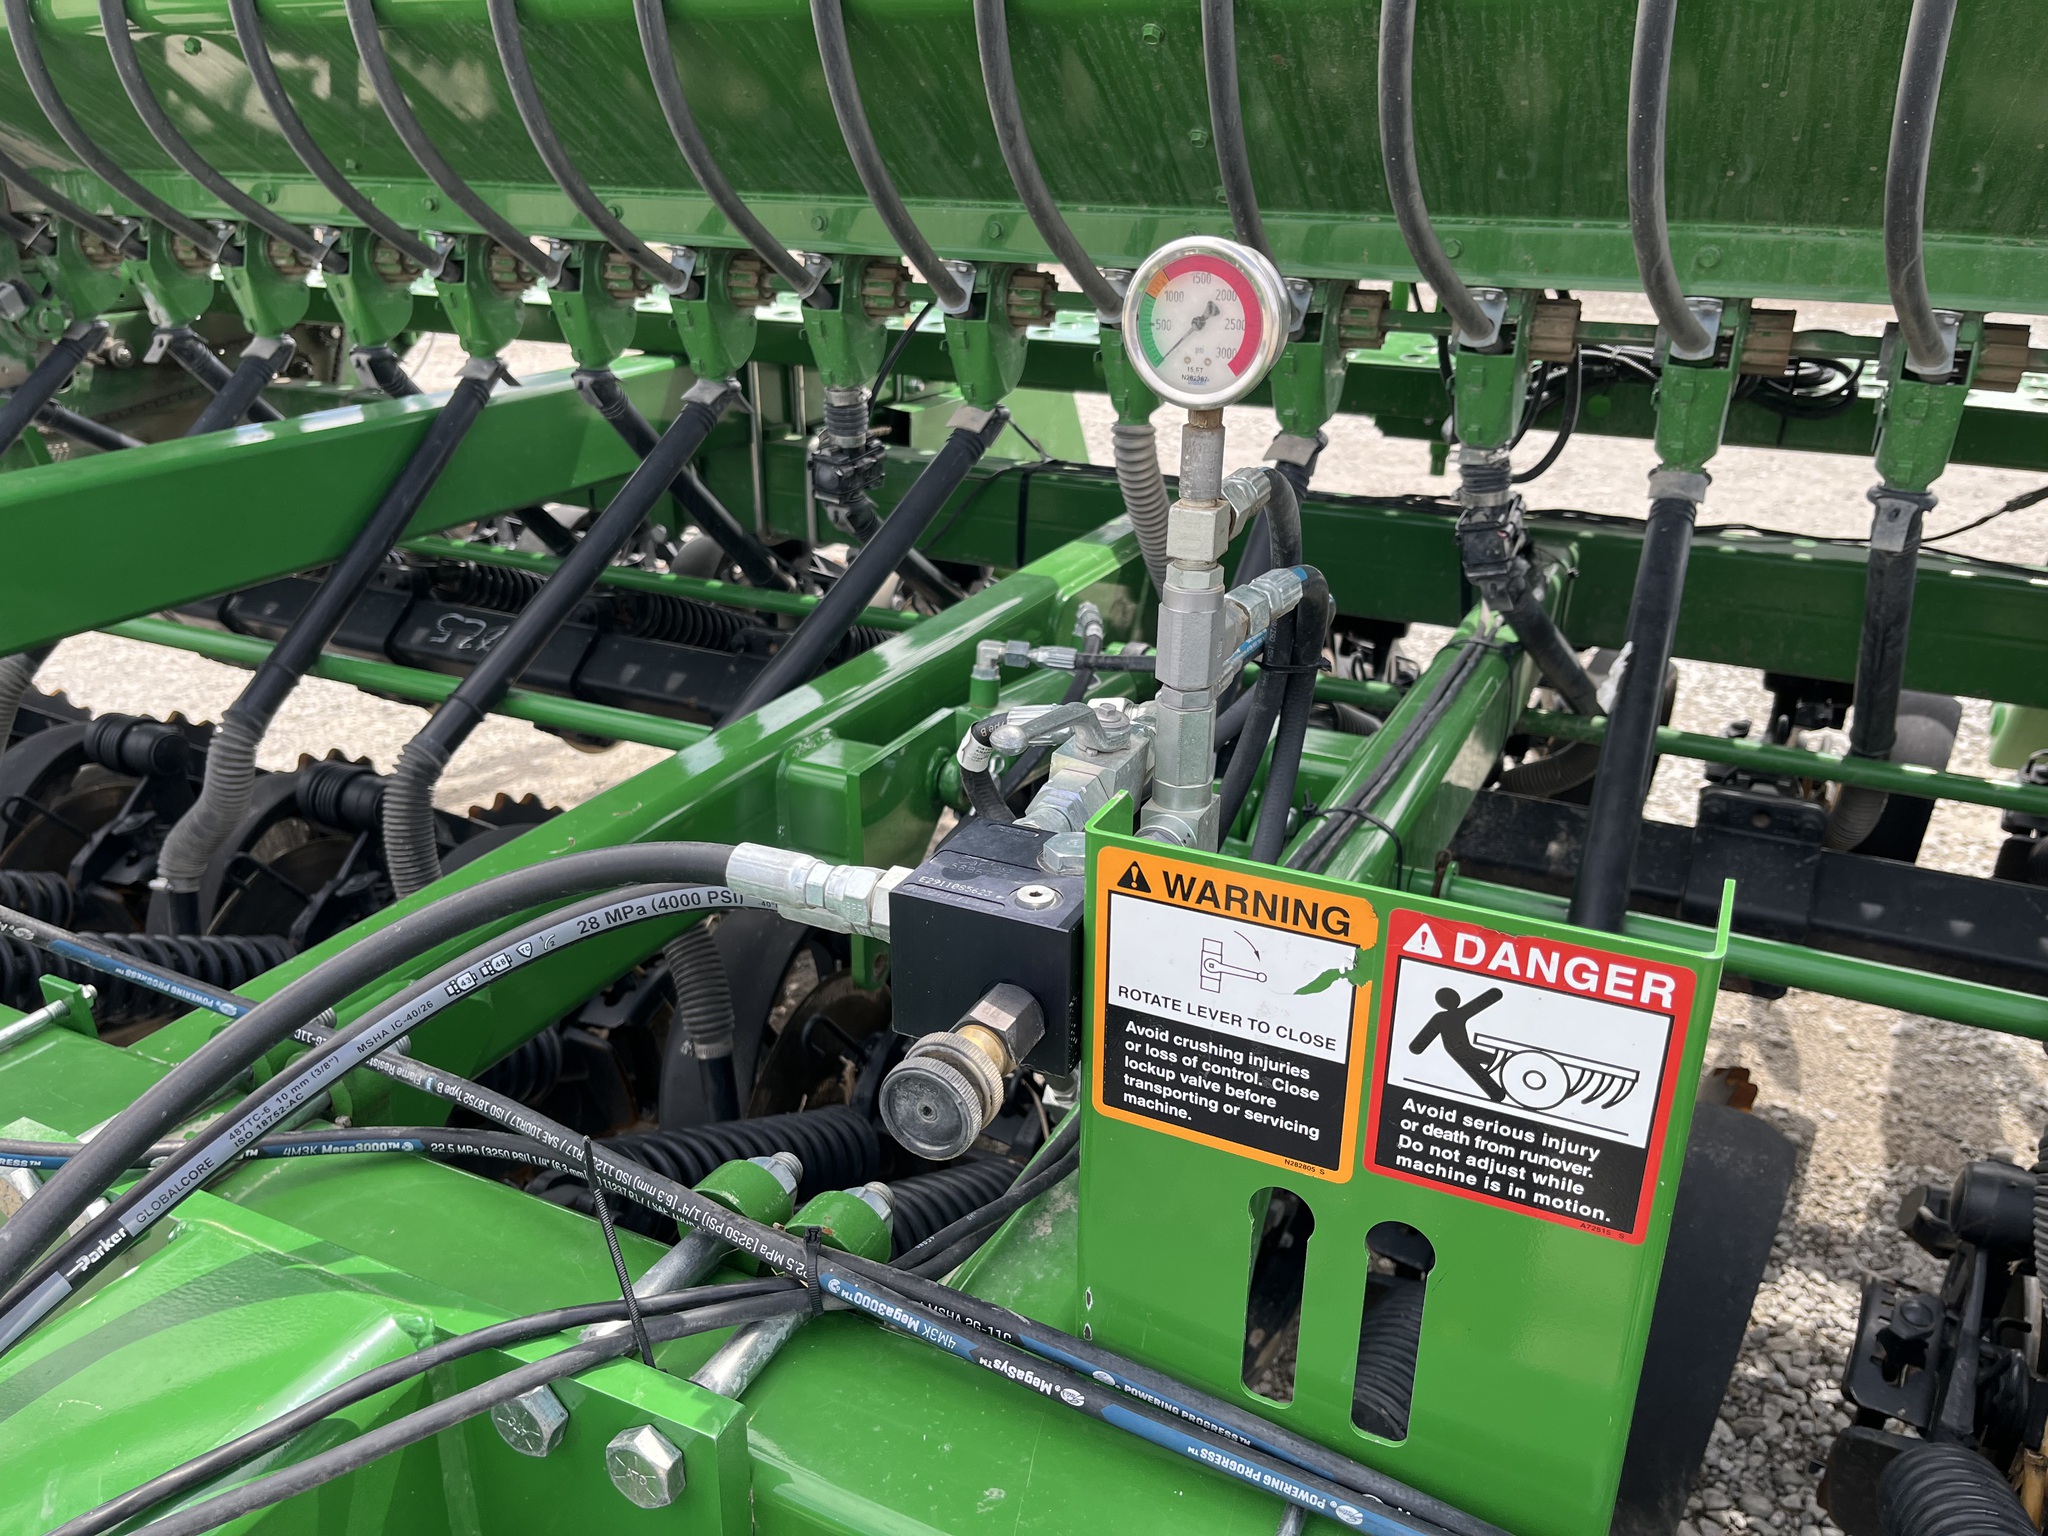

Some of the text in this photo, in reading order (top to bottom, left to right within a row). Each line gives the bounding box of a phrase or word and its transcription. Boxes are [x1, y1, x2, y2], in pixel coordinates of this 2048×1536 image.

[1192, 273, 1212, 285] 1500
[1165, 291, 1184, 302] 1000
[1216, 289, 1237, 302] 2000
[1155, 319, 1171, 331] 500
[1224, 318, 1245, 331] 2500
[1215, 347, 1236, 360] 3000
[576, 889, 745, 936] 28 MPa (4000 PSI)
[1162, 871, 1350, 937] WARNING
[1453, 932, 1676, 1009] DANGER
[170, 983, 214, 1007] POWERING
[357, 1000, 434, 1054] MSHA IC-40/26
[1118, 986, 1337, 1051] ROTATE LEVER TO CLOSE
[1125, 1020, 1310, 1080] Avoid crushing injuries
[397, 1066, 422, 1087] Flame
[1124, 1040, 1320, 1101] or loss of control. Close
[1124, 1056, 1277, 1108] lockup valve before
[436, 1081, 445, 1094] B
[444, 1081, 464, 1104] Type
[463, 1090, 491, 1113] 18752
[228, 1105, 271, 1142] 487TC-6
[275, 1089, 291, 1104] 10
[291, 1076, 311, 1096] mm
[234, 1092, 305, 1148] ISO 18752-AC
[488, 1101, 504, 1119] ISO
[1123, 1092, 1192, 1121] machine.
[1123, 1073, 1320, 1141] transporting or servicing
[511, 1110, 543, 1138] 100R17
[542, 1125, 561, 1143] SAE
[1402, 1097, 1600, 1162] Avoid serious injury
[430, 1142, 455, 1155] 22.5
[457, 1142, 480, 1157] MPa
[481, 1145, 510, 1162] (3250
[566, 1140, 585, 1162] R17
[1400, 1119, 1594, 1178] or death from runover.
[615, 1169, 633, 1188] ISO
[1284, 1158, 1316, 1173] N282805
[1399, 1134, 1584, 1195] Do not adjust while
[135, 1157, 216, 1225] GLOBALCORE
[1396, 1154, 1611, 1222] machine is in motion.
[1580, 1221, 1612, 1236] A72515
[64, 1227, 128, 1278] Parker
[759, 1243, 787, 1267] MPa
[921, 1325, 957, 1350] 4M3K
[1124, 1384, 1180, 1416] POWERING
[1263, 1473, 1326, 1510] POWERING
